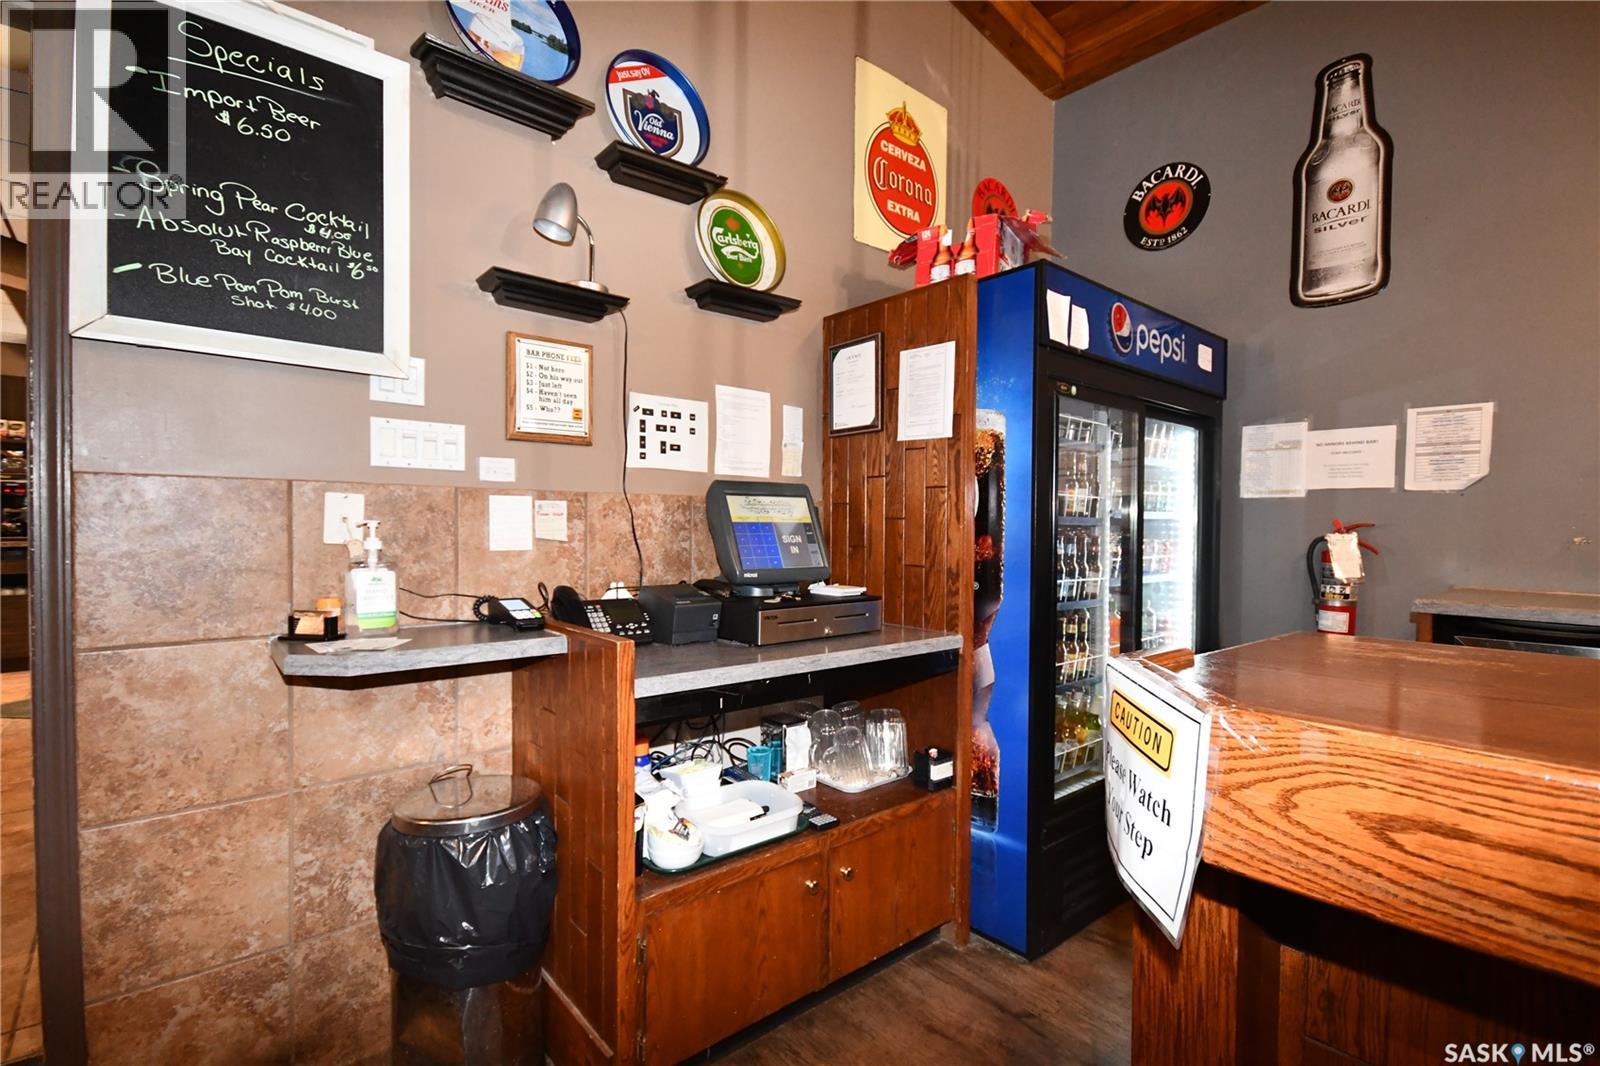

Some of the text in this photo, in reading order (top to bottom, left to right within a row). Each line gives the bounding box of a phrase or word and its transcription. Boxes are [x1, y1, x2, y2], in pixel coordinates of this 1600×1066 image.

[178, 20, 325, 92] Specials
[616, 67, 651, 81] Just say OV
[148, 69, 321, 130] Import Beer
[215, 110, 291, 142] $6.50
[634, 110, 674, 140] Vienna
[648, 116, 663, 127] Old
[880, 140, 927, 172] CERVEZA
[873, 156, 932, 206] Corona
[1131, 164, 1204, 202] BACARDI
[219, 181, 279, 213] Pear
[285, 203, 370, 240] Cocktail
[887, 199, 920, 223] EXTRA
[1311, 199, 1371, 224] BACARDI
[136, 205, 248, 238] Absolut
[331, 240, 374, 263] Blue
[712, 227, 759, 256] Carlsberg
[1167, 226, 1188, 244] 1862
[210, 238, 252, 265] Bay
[264, 248, 339, 273] Cocktail
[148, 263, 360, 310] Blue Pom Pom Burst
[231, 294, 338, 320] Shot $4.00
[526, 348, 540, 357] BAR
[541, 351, 565, 361] PHONE
[1136, 323, 1186, 364] pepsi
[550, 365, 565, 373] here
[781, 535, 802, 544] SIGN
[790, 545, 800, 554] IN
[1114, 701, 1163, 754] CAUTION
[1127, 769, 1171, 827] Watch
[1124, 812, 1154, 859] Step
